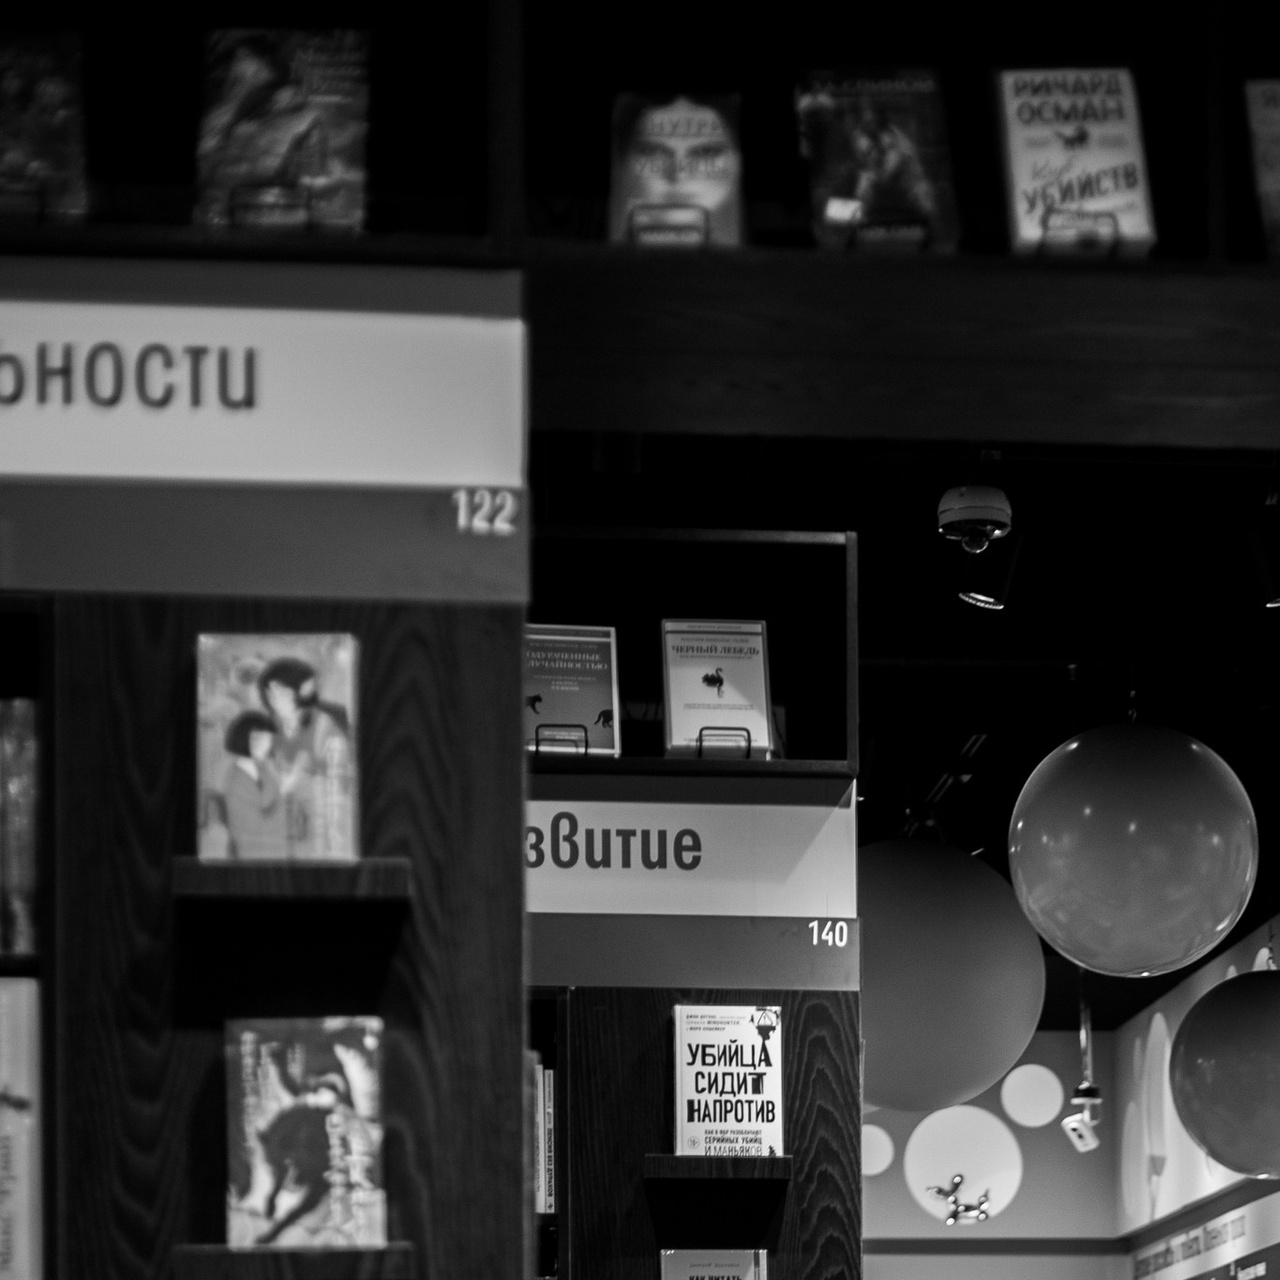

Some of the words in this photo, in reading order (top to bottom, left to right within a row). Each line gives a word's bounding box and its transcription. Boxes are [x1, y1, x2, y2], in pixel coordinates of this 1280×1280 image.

[1013, 74, 1123, 97] РИЧАРД
[1017, 98, 1126, 122] ОСМАН
[453, 488, 517, 536] 122
[719, 645, 761, 657] ЛЕБЕДЬ
[527, 661, 608, 672] ЛУЧАЙНОСТЬЮ
[525, 810, 703, 871] звитие
[808, 920, 848, 947] 140
[686, 1038, 773, 1070] УБИЙЦА
[694, 1071, 767, 1098] СИДИТ
[686, 1099, 776, 1123] НАПРОТИВ
